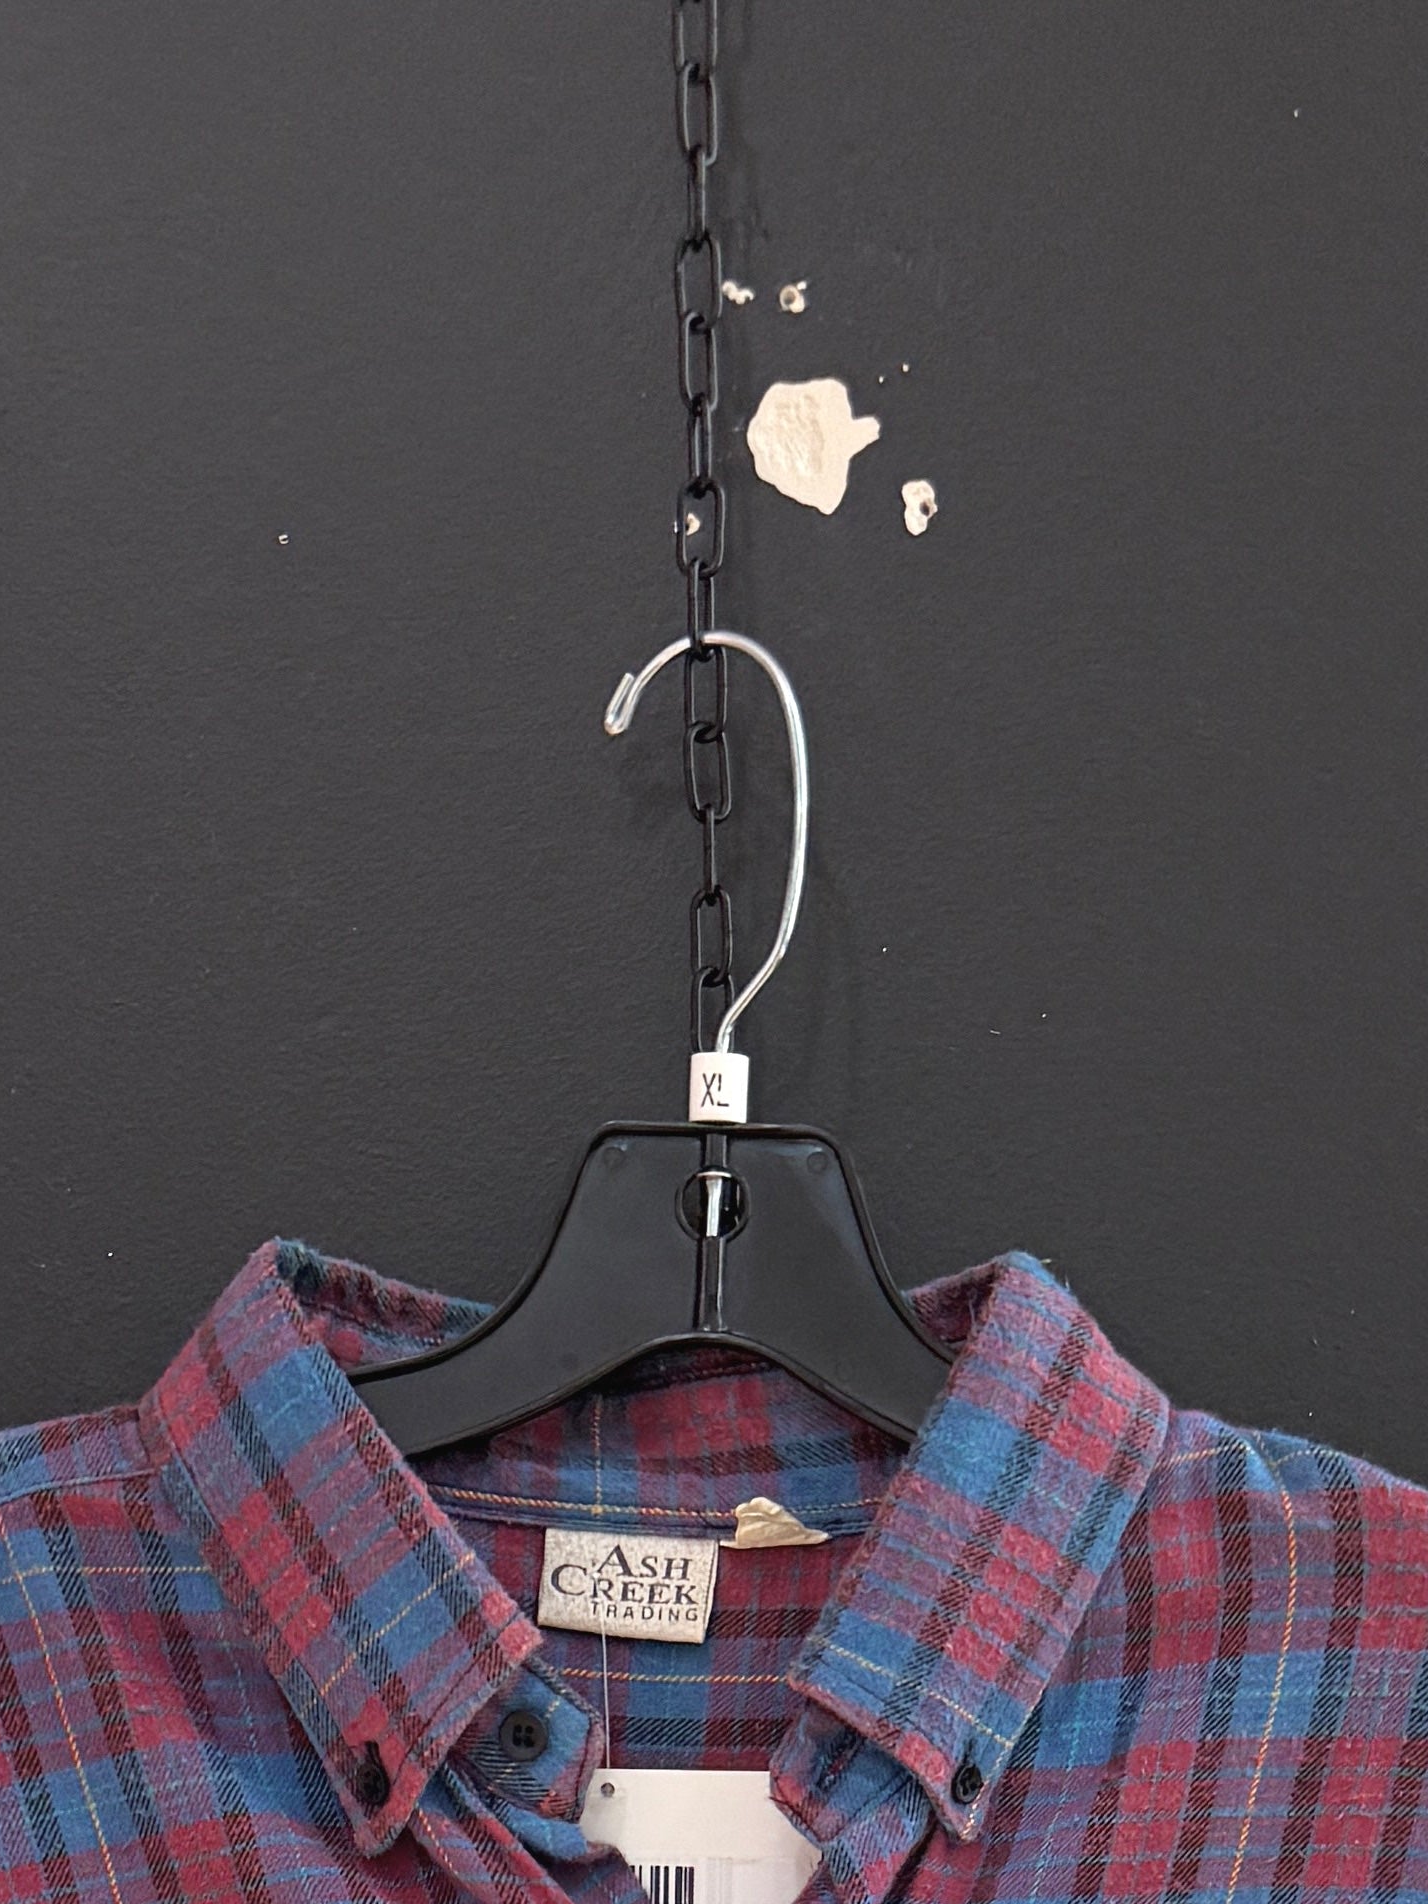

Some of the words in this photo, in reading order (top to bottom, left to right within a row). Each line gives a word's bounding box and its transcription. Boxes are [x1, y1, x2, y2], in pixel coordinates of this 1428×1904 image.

[701, 1073, 729, 1107] XL
[596, 1544, 693, 1581] ASH
[551, 1563, 699, 1605] CREEK
[591, 1601, 698, 1621] TRADING
